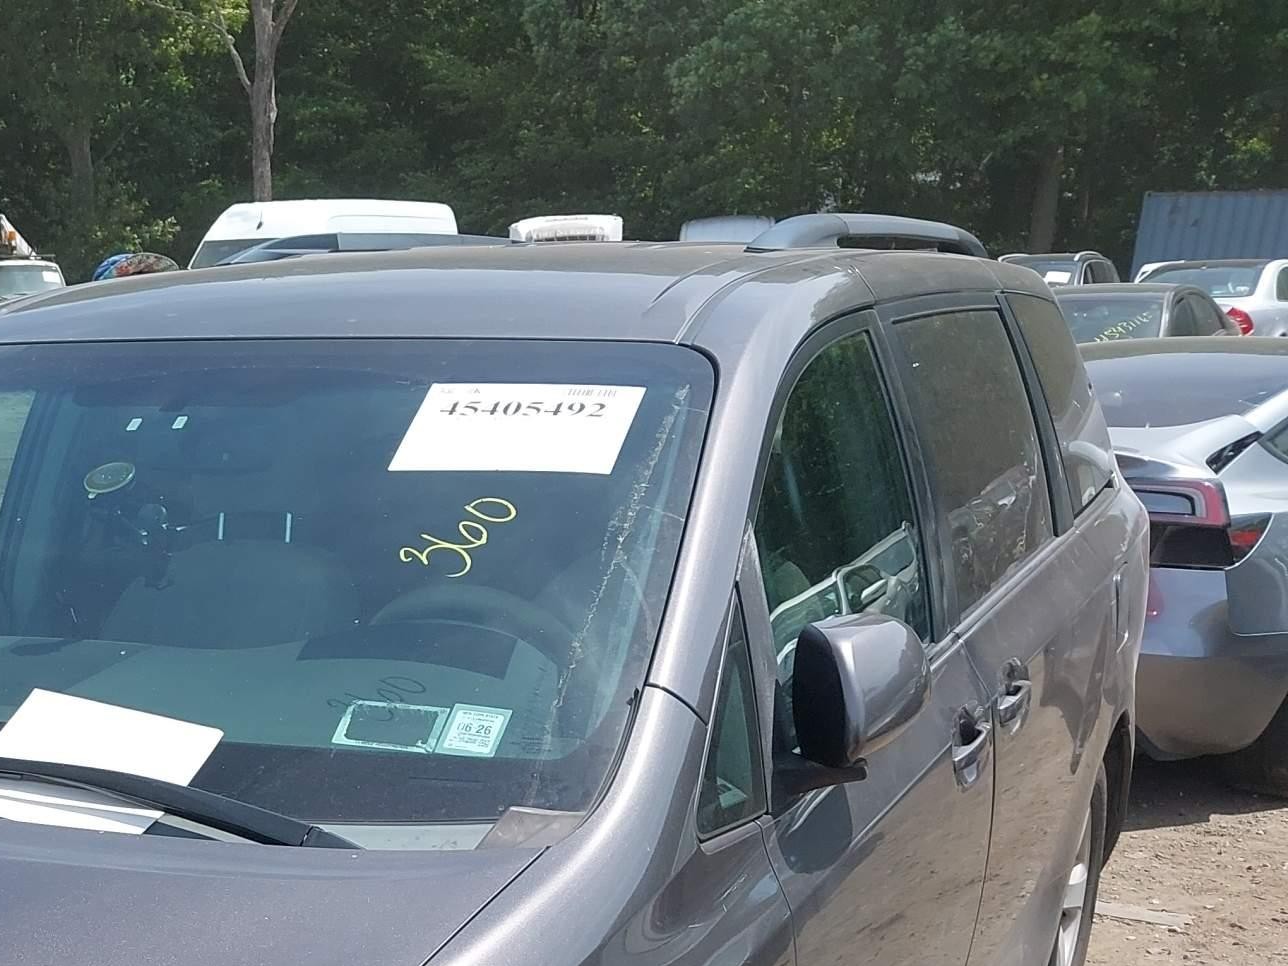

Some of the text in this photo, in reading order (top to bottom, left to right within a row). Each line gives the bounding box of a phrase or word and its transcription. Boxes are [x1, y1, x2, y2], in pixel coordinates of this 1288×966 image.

[439, 401, 607, 418] 45405492
[399, 497, 517, 578] 360
[475, 724, 493, 736] 26
